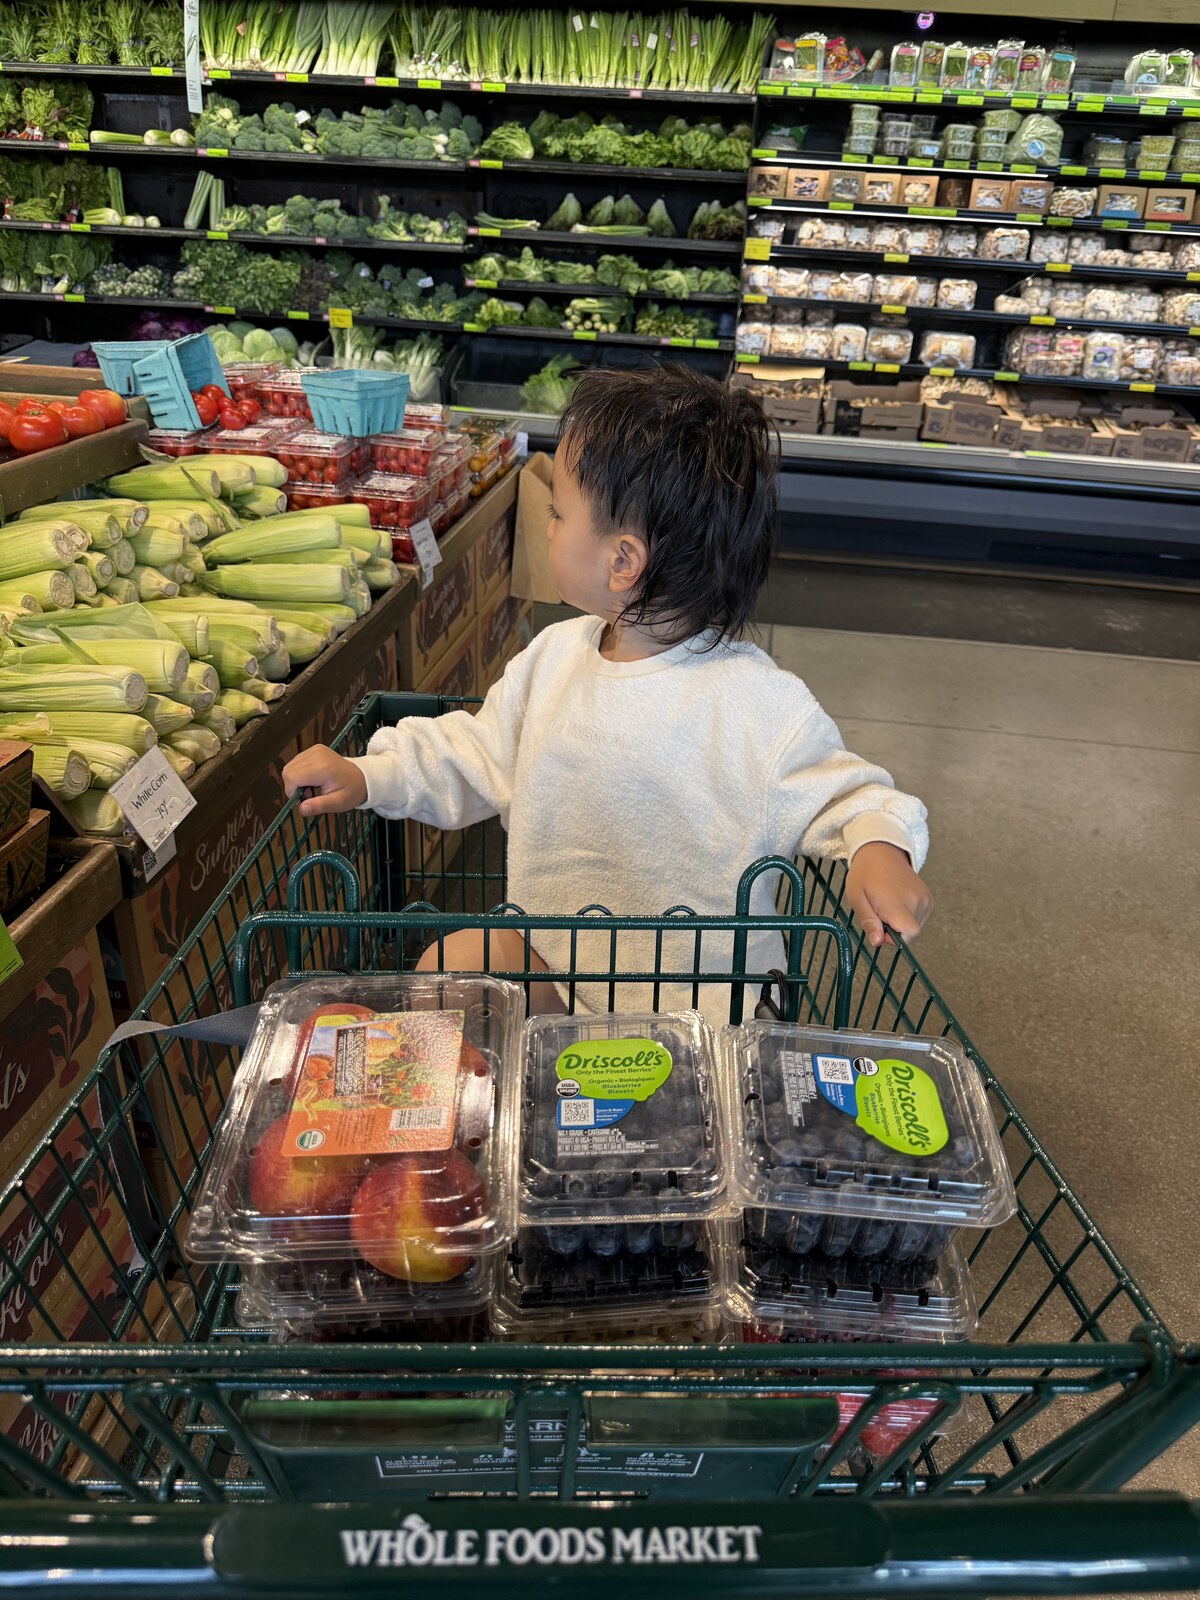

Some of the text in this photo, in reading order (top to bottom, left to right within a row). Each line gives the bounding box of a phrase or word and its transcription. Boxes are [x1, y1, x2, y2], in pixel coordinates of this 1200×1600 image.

[131, 786, 153, 810] White
[190, 797, 255, 891] Sunrise
[562, 1051, 663, 1069] Driscoll's
[875, 1083, 885, 1103] Organic
[891, 1097, 900, 1116] Finest
[891, 1066, 932, 1148] Driscoll's
[341, 1523, 762, 1566] WHOLE FOODS MARKET
